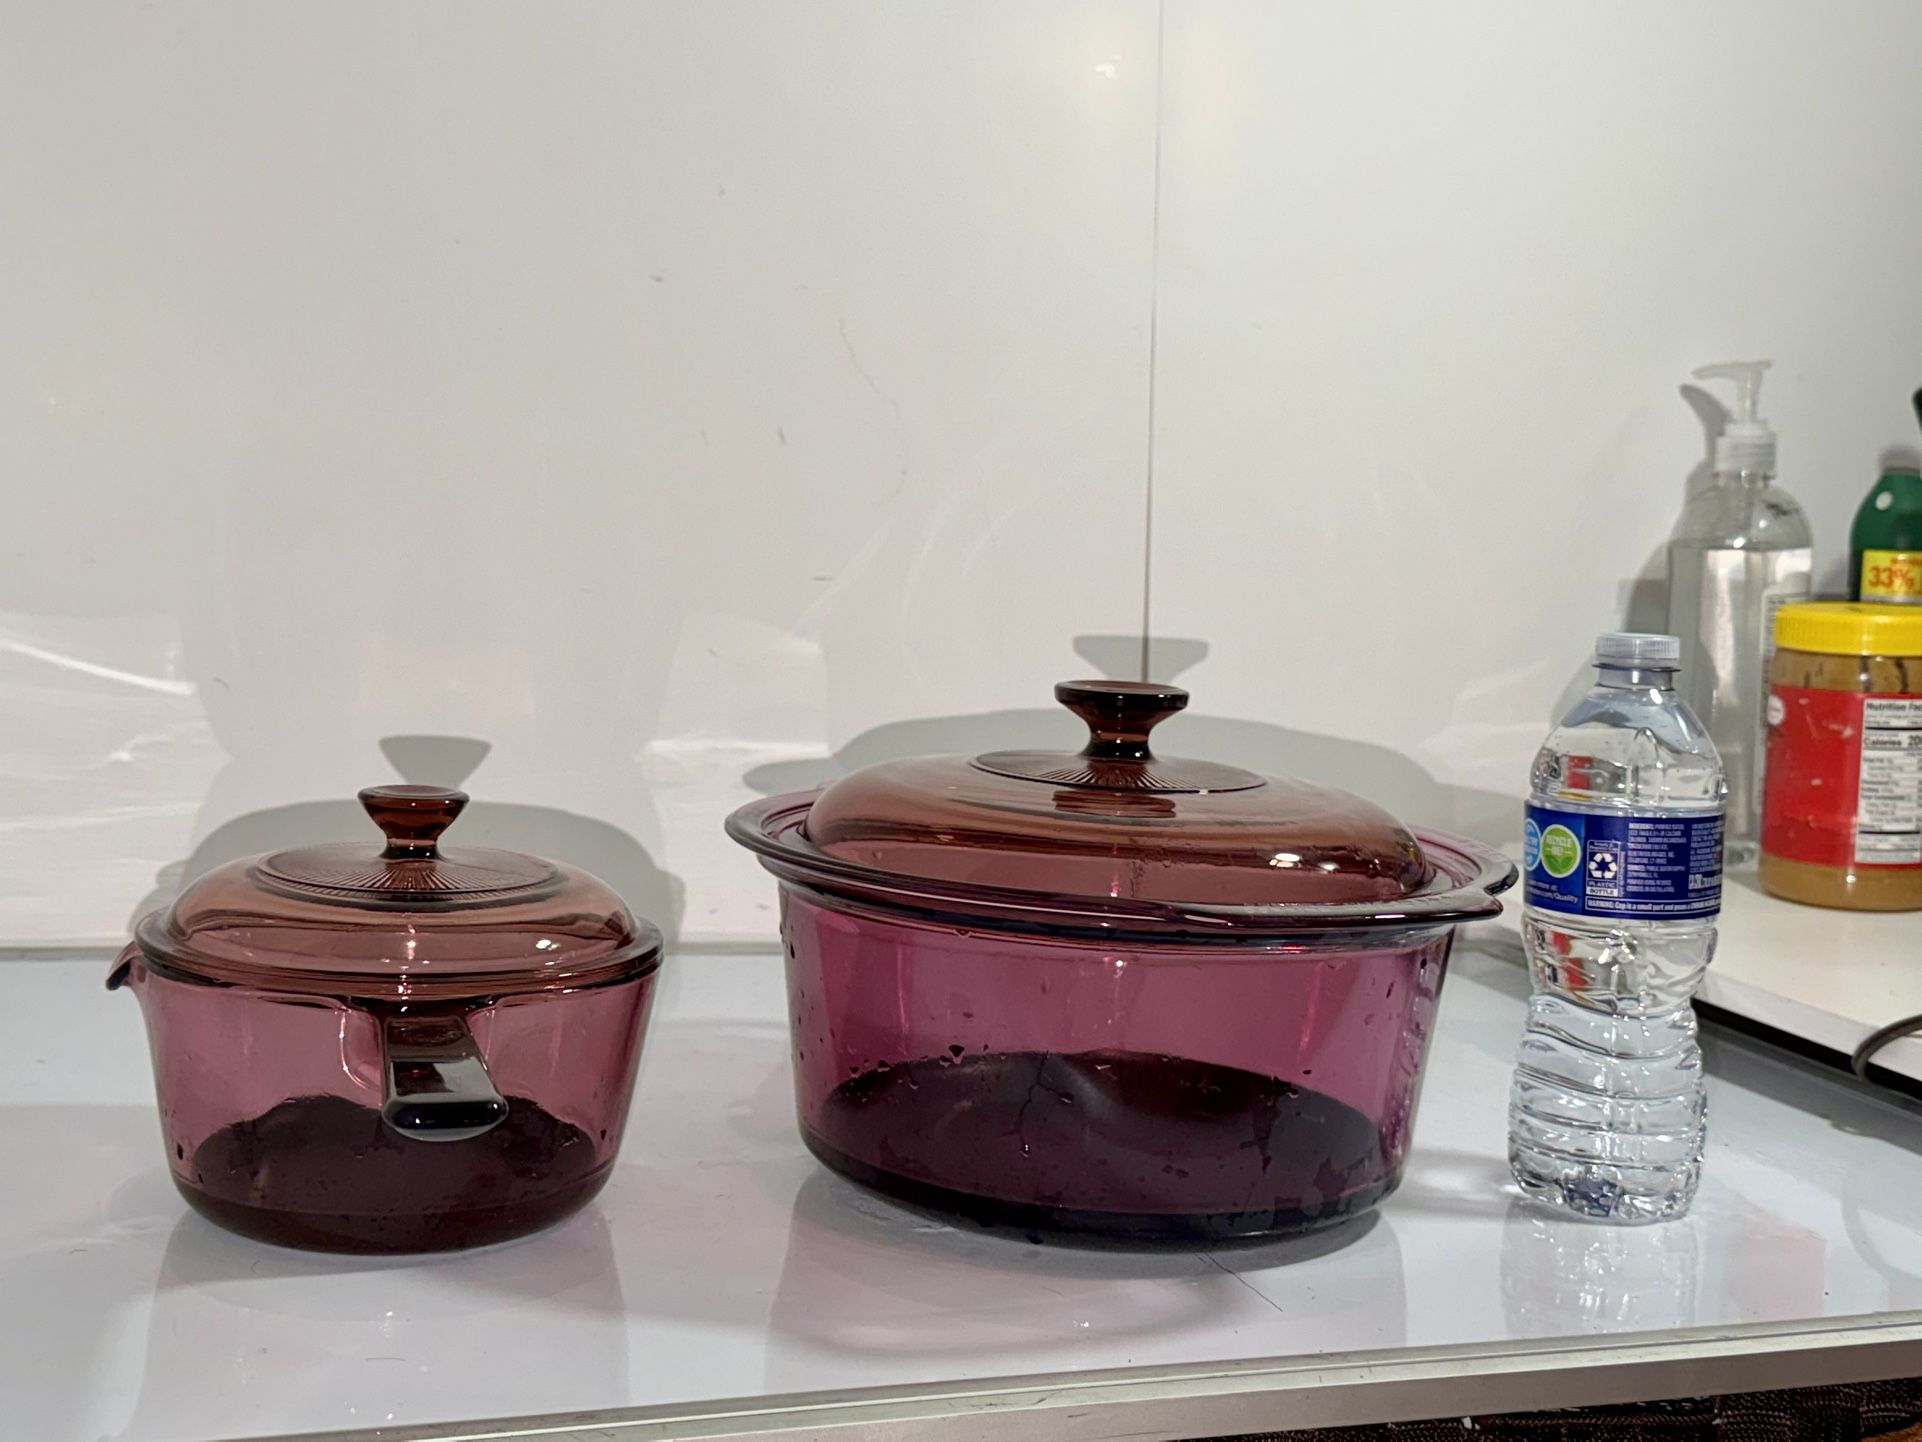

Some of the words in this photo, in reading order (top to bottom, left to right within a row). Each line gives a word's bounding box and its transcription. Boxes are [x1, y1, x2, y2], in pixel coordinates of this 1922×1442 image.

[1868, 565, 1915, 590] 33%
[1866, 702, 1906, 712] Nutrition
[1864, 737, 1902, 746] Calories
[1589, 881, 1616, 889] PLASTIC
